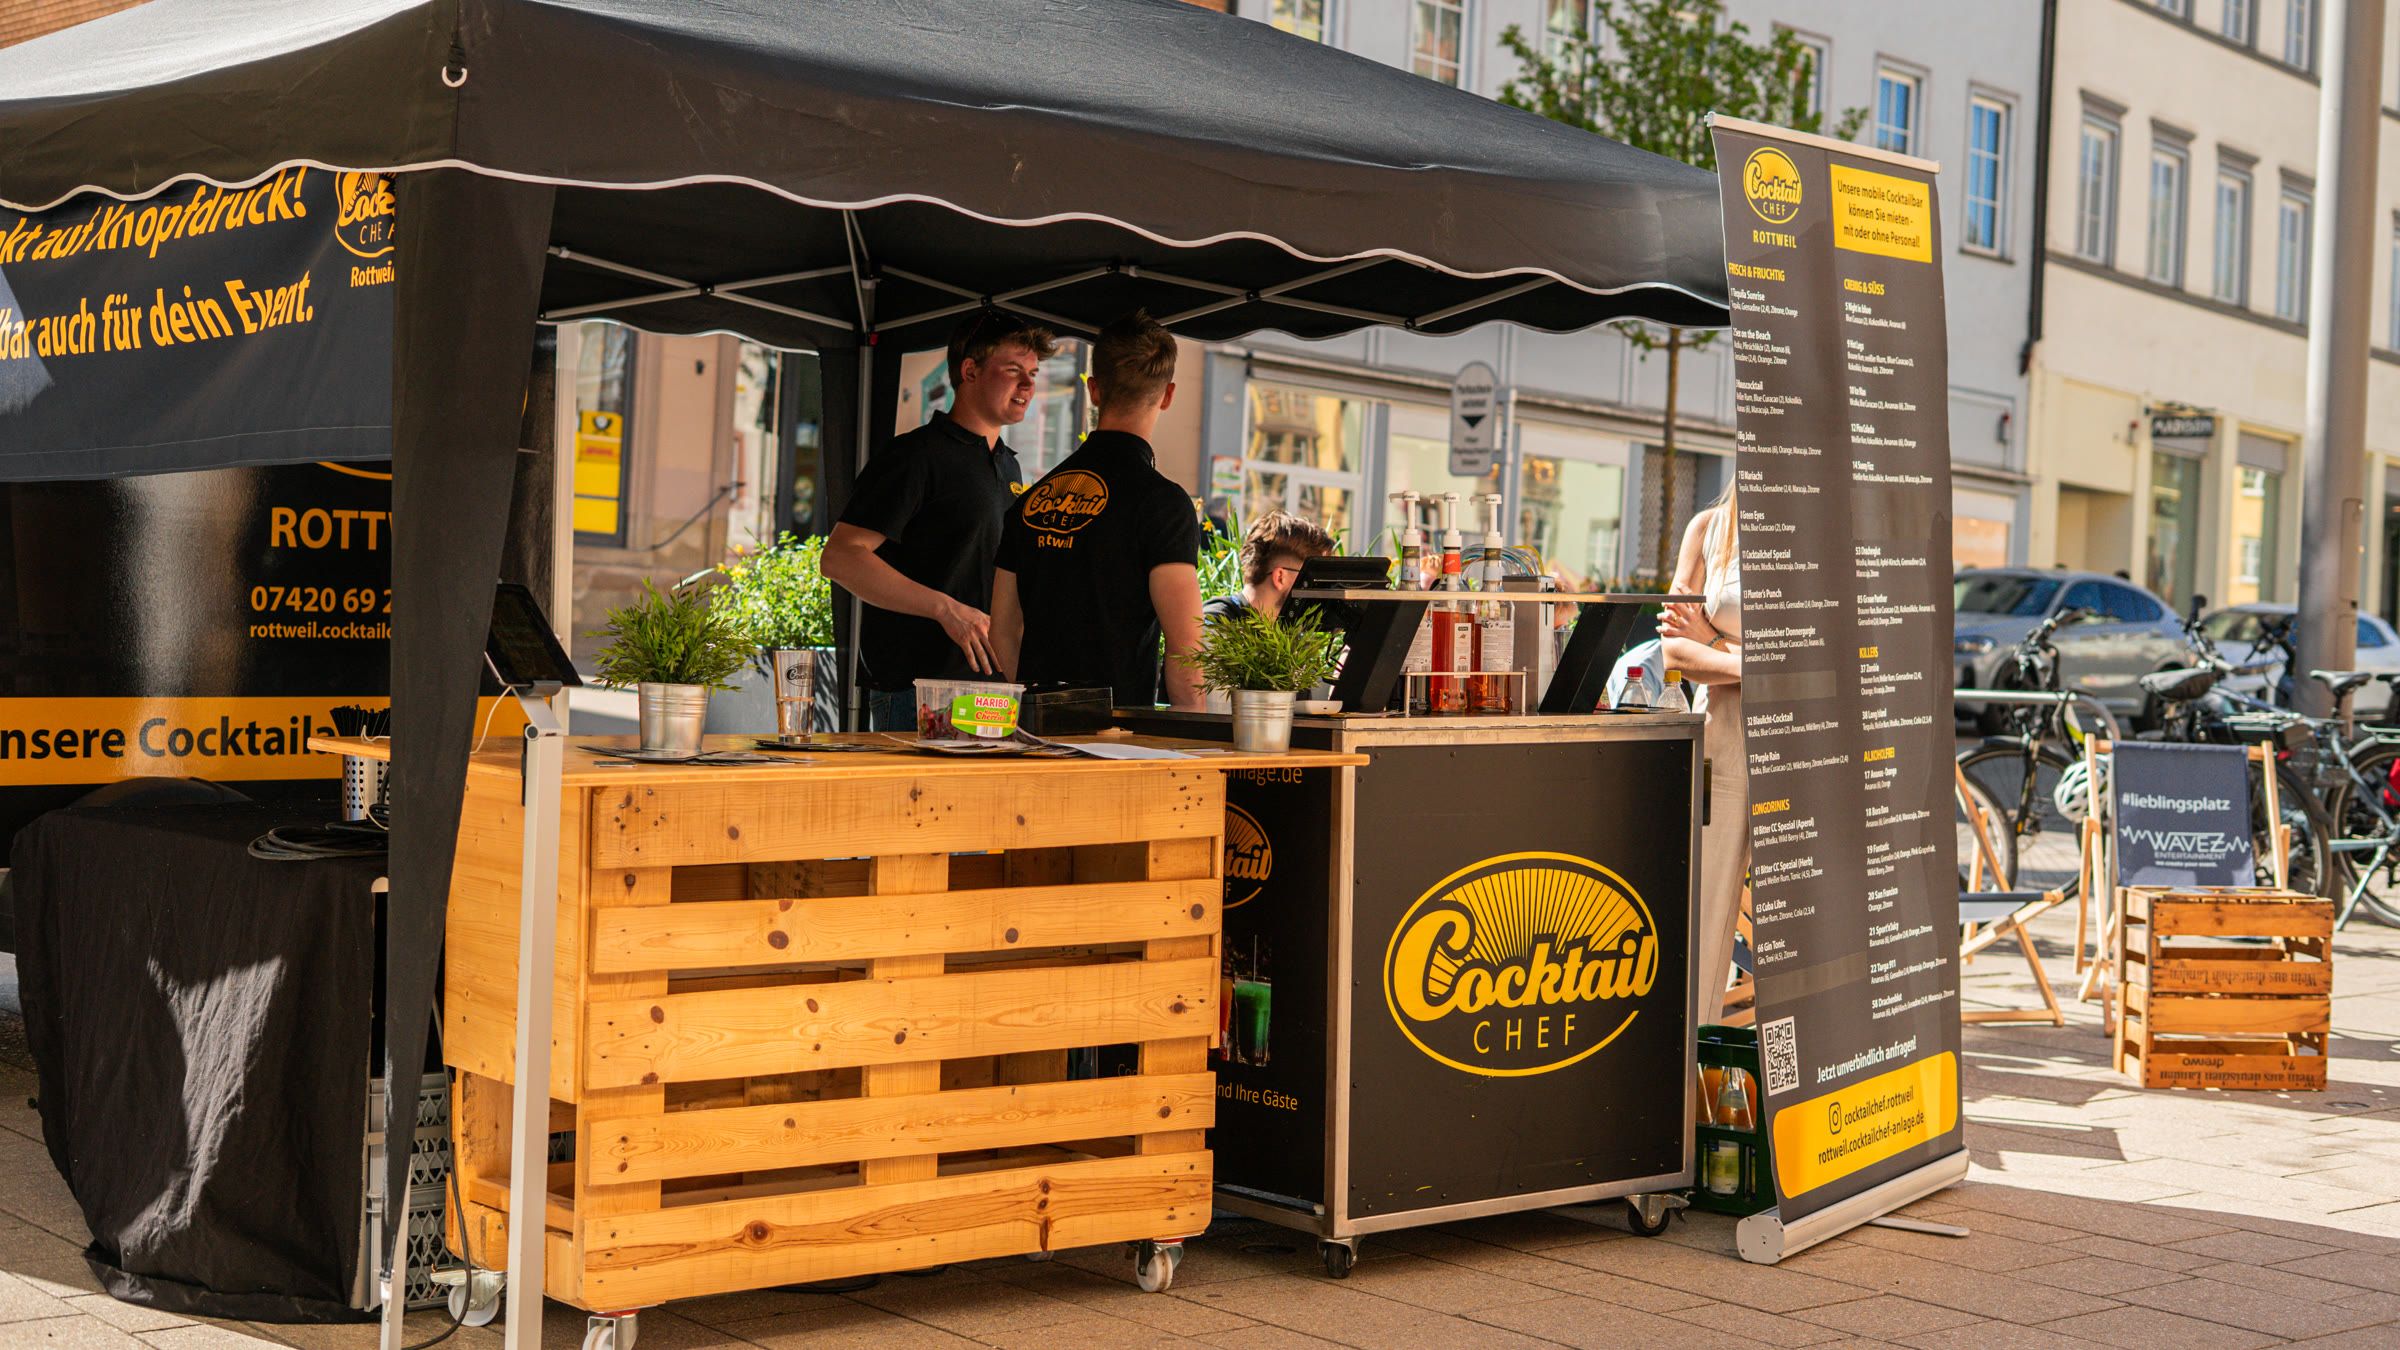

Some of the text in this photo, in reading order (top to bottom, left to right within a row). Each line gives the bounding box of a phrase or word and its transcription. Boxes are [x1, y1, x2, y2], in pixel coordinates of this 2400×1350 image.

[1747, 162, 1801, 205] Cocktail
[1838, 180, 1923, 208] Unsere mobile Cocktailbar
[32, 206, 102, 257] auf
[91, 166, 307, 259] Knopfdruck!
[1763, 202, 1786, 217] CHEF
[1849, 204, 1874, 220] können
[1876, 207, 1885, 221] Sie
[1886, 212, 1909, 226] mieten
[1753, 230, 1797, 248] ROTTWEIL
[1844, 224, 1920, 248] mit oder ohne Personal!
[1868, 281, 1885, 295] SÜSS
[38, 298, 95, 358] auch
[102, 292, 142, 352] für
[149, 285, 234, 349] dein
[224, 270, 314, 335] Event.
[1024, 483, 1108, 516] Cocktail
[251, 586, 337, 612] 07420
[342, 588, 376, 613] 69
[975, 697, 1009, 708] HARIBO
[0, 727, 126, 760] nsere
[1770, 752, 1780, 761] Rain
[1752, 799, 1790, 815] LONGDRINKS
[2122, 792, 2231, 814] #lieblingsplatz
[1778, 820, 1795, 833] Spezial
[2150, 832, 2224, 852] WAVEZ
[1780, 859, 1797, 872] Spezial
[2154, 852, 2226, 860] ENTERTAINMENT
[1762, 902, 1774, 912] Cuba
[1774, 899, 1786, 909] Libre
[1757, 944, 1763, 953] 66
[1772, 939, 1785, 949] Tonic
[1394, 909, 1654, 1022] Cocktail
[1870, 964, 1877, 973] 22
[1474, 1014, 1576, 1054] CHEF
[1817, 1034, 1917, 1084] Jetzt unverbindlich anfragen!
[2264, 1072, 2285, 1084] aus
[2287, 1072, 2316, 1086] Wein
[1236, 1084, 1260, 1104] Ihre
[1262, 1089, 1298, 1110] Gäste
[1844, 1085, 1914, 1126] cocktailchef.rottweil
[1818, 1110, 1924, 1164] rottweil.cocktailchef-anlage.de
